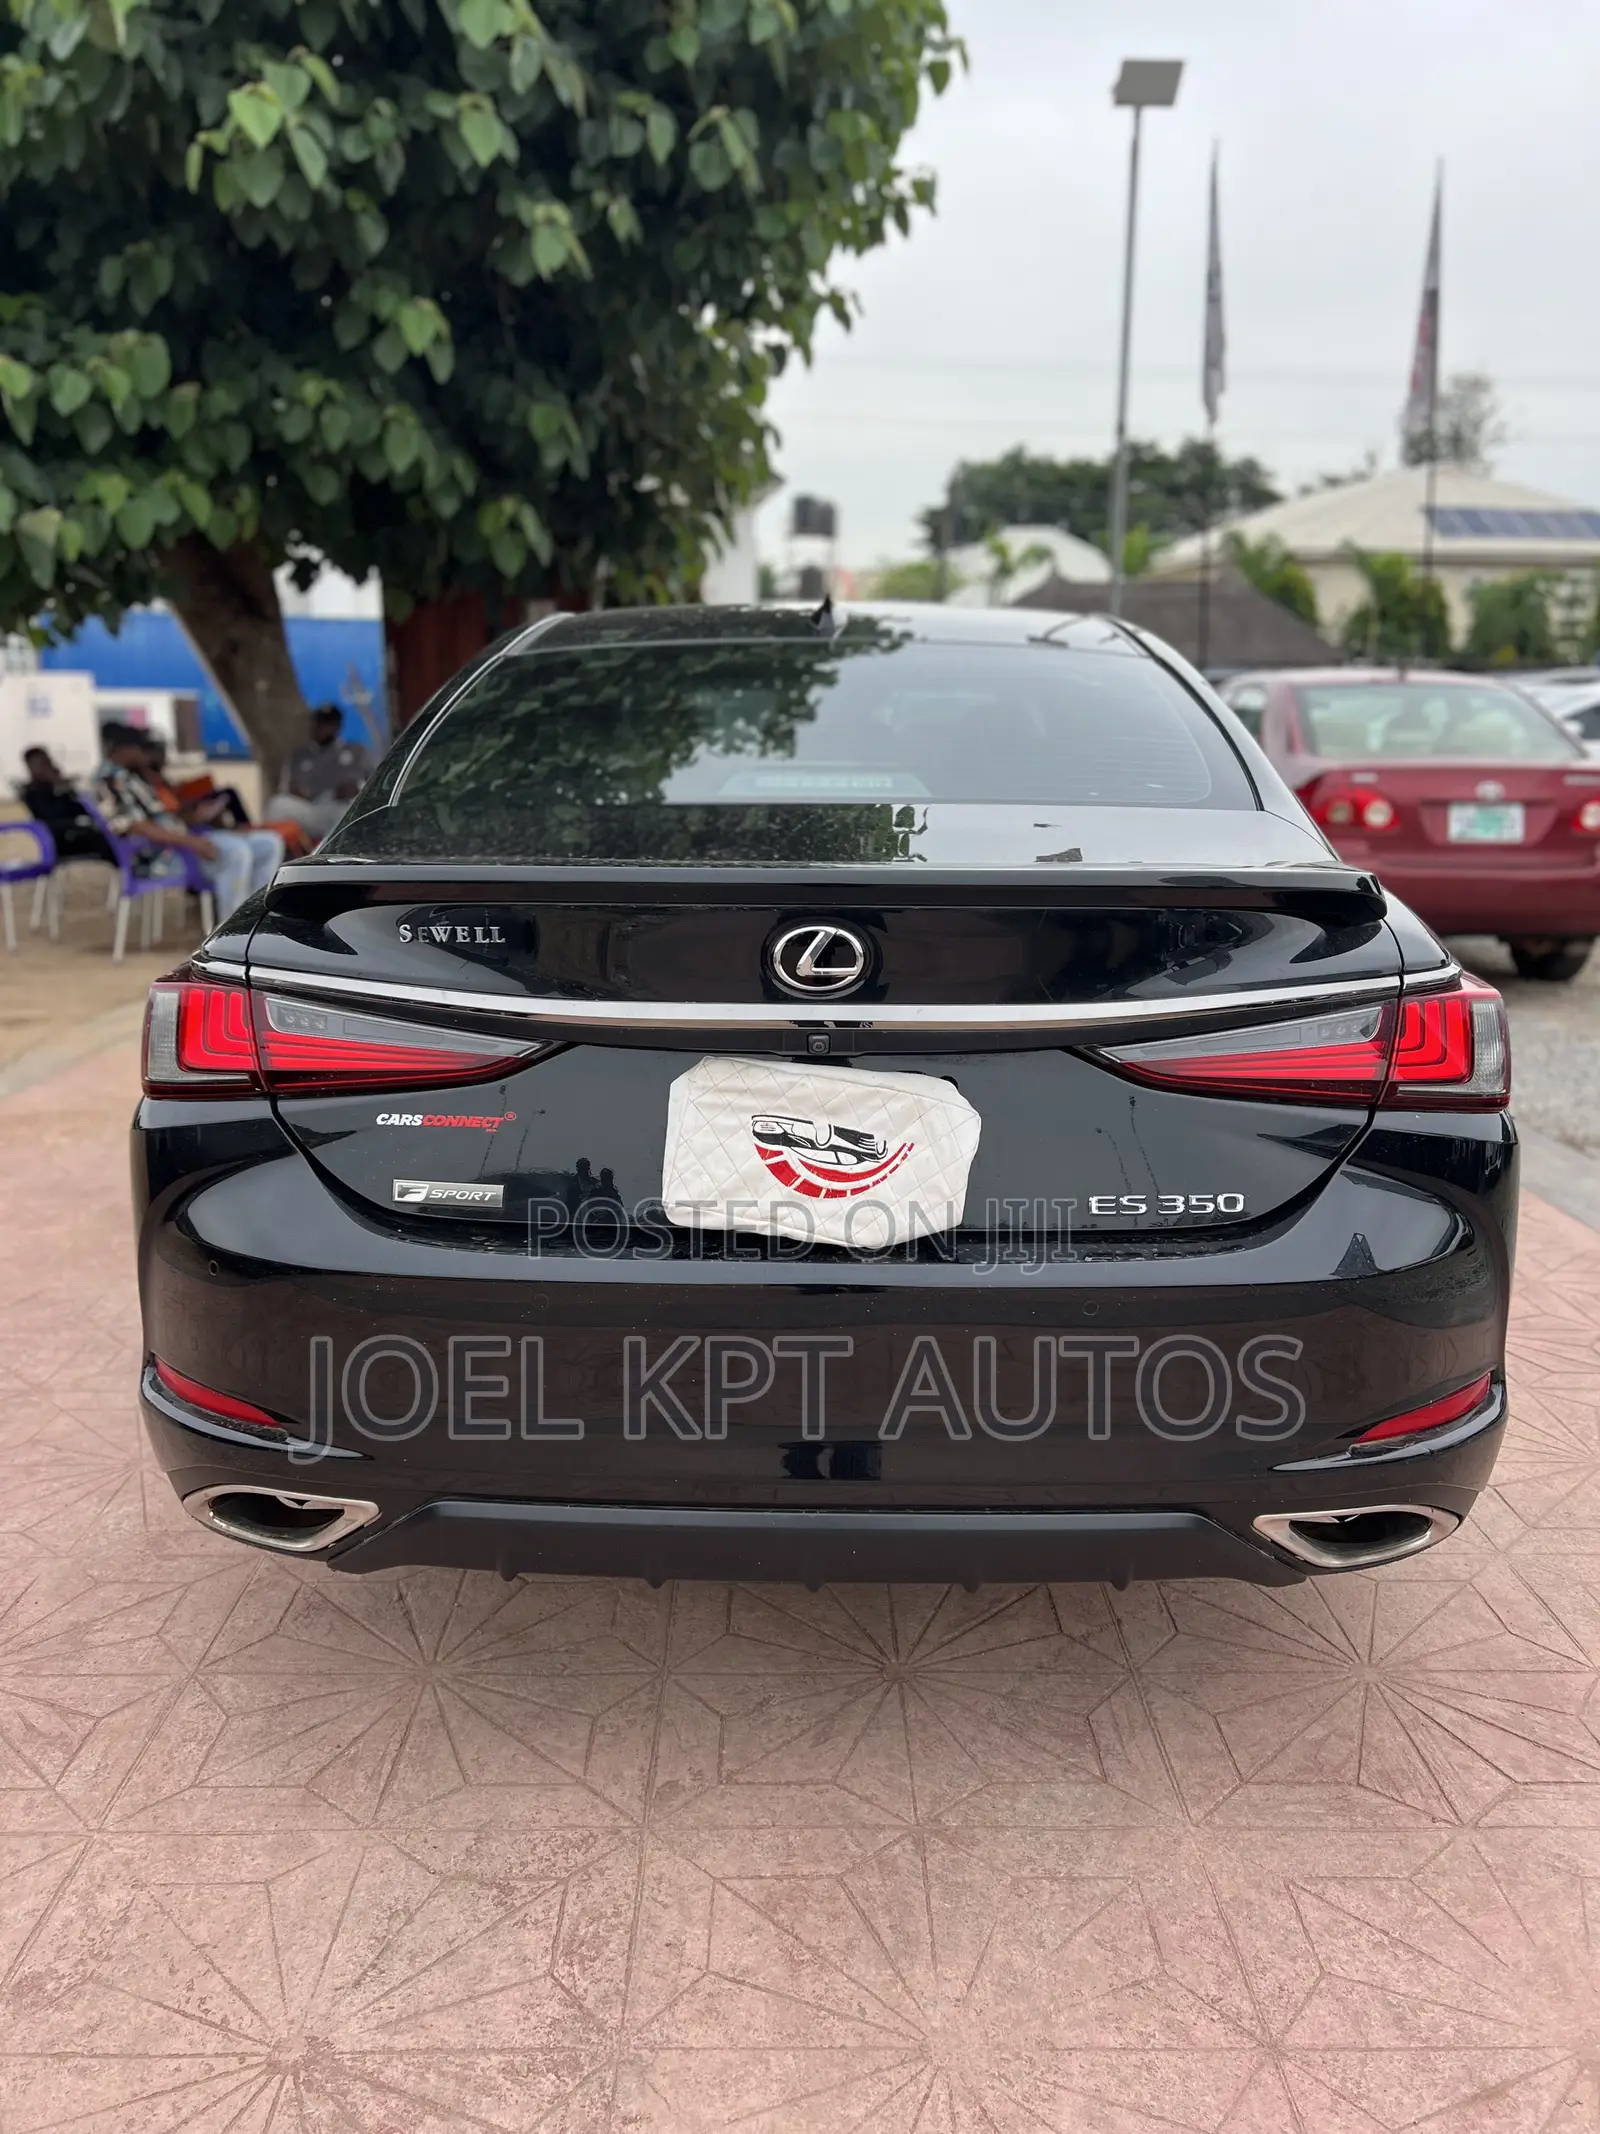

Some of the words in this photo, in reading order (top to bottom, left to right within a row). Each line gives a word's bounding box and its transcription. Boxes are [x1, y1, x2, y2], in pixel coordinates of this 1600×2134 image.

[399, 924, 506, 943] SEWELL
[428, 1188, 497, 1201] SPORT
[1088, 1194, 1148, 1215] ES
[1157, 1192, 1245, 1215] 350
